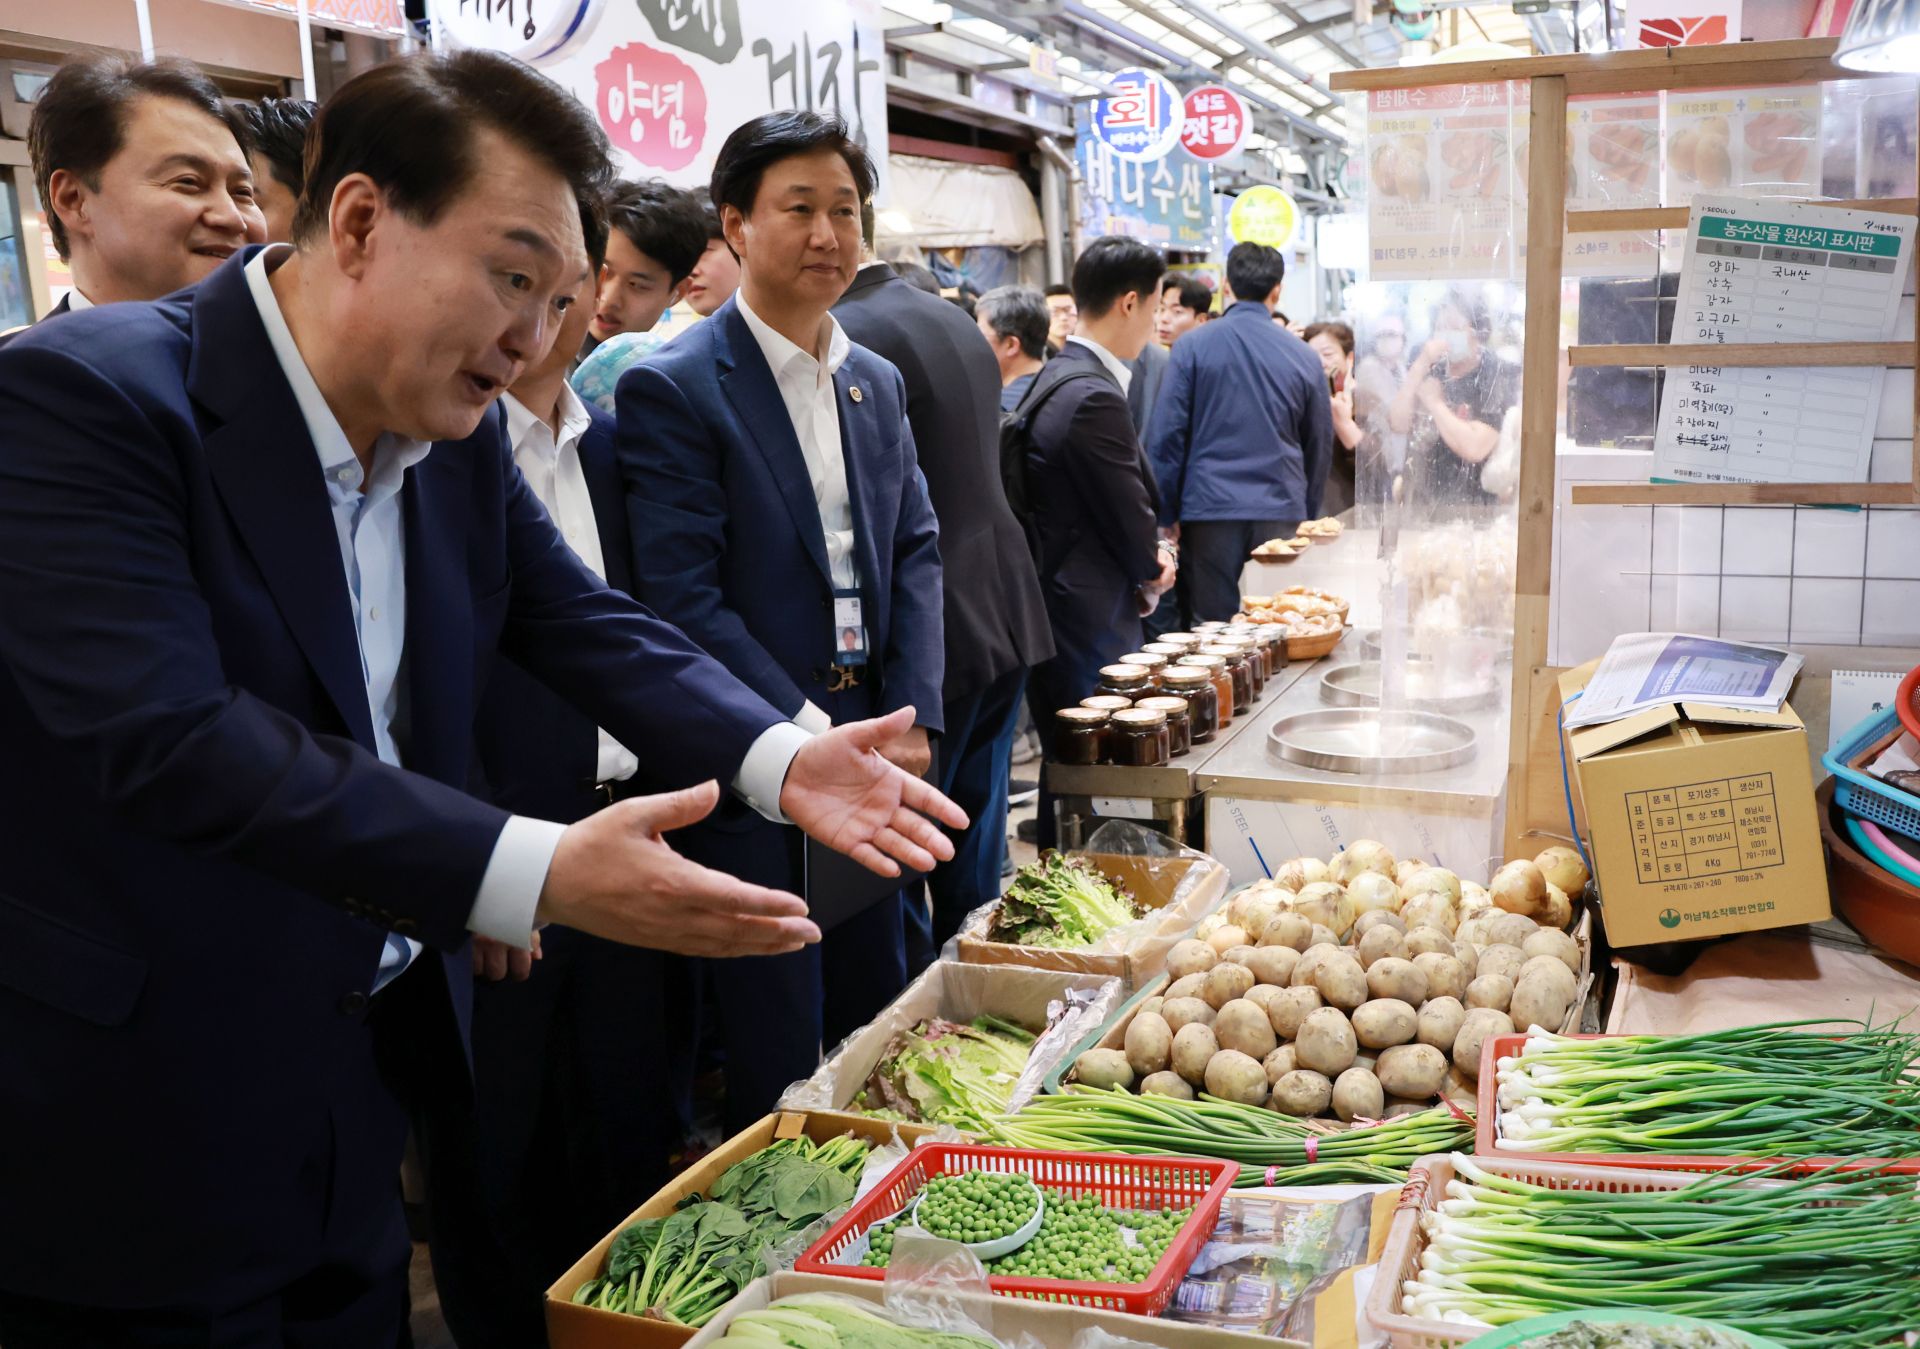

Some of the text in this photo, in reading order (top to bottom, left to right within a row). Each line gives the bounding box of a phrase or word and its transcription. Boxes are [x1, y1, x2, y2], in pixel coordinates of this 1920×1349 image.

[608, 63, 694, 150] 양념
[1103, 79, 1159, 131] 회
[1193, 94, 1226, 111] 남도
[1724, 221, 1875, 252] 농수산물 원산지 표시판
[1772, 266, 1811, 281] 국내산
[1687, 787, 1721, 801] 포기상추
[1739, 779, 1764, 792] 생산자
[1745, 804, 1764, 816] 하남시
[1231, 806, 1249, 835] STEEL
[1320, 813, 1341, 842] STEEL
[1689, 831, 1731, 847] 경기 하남시
